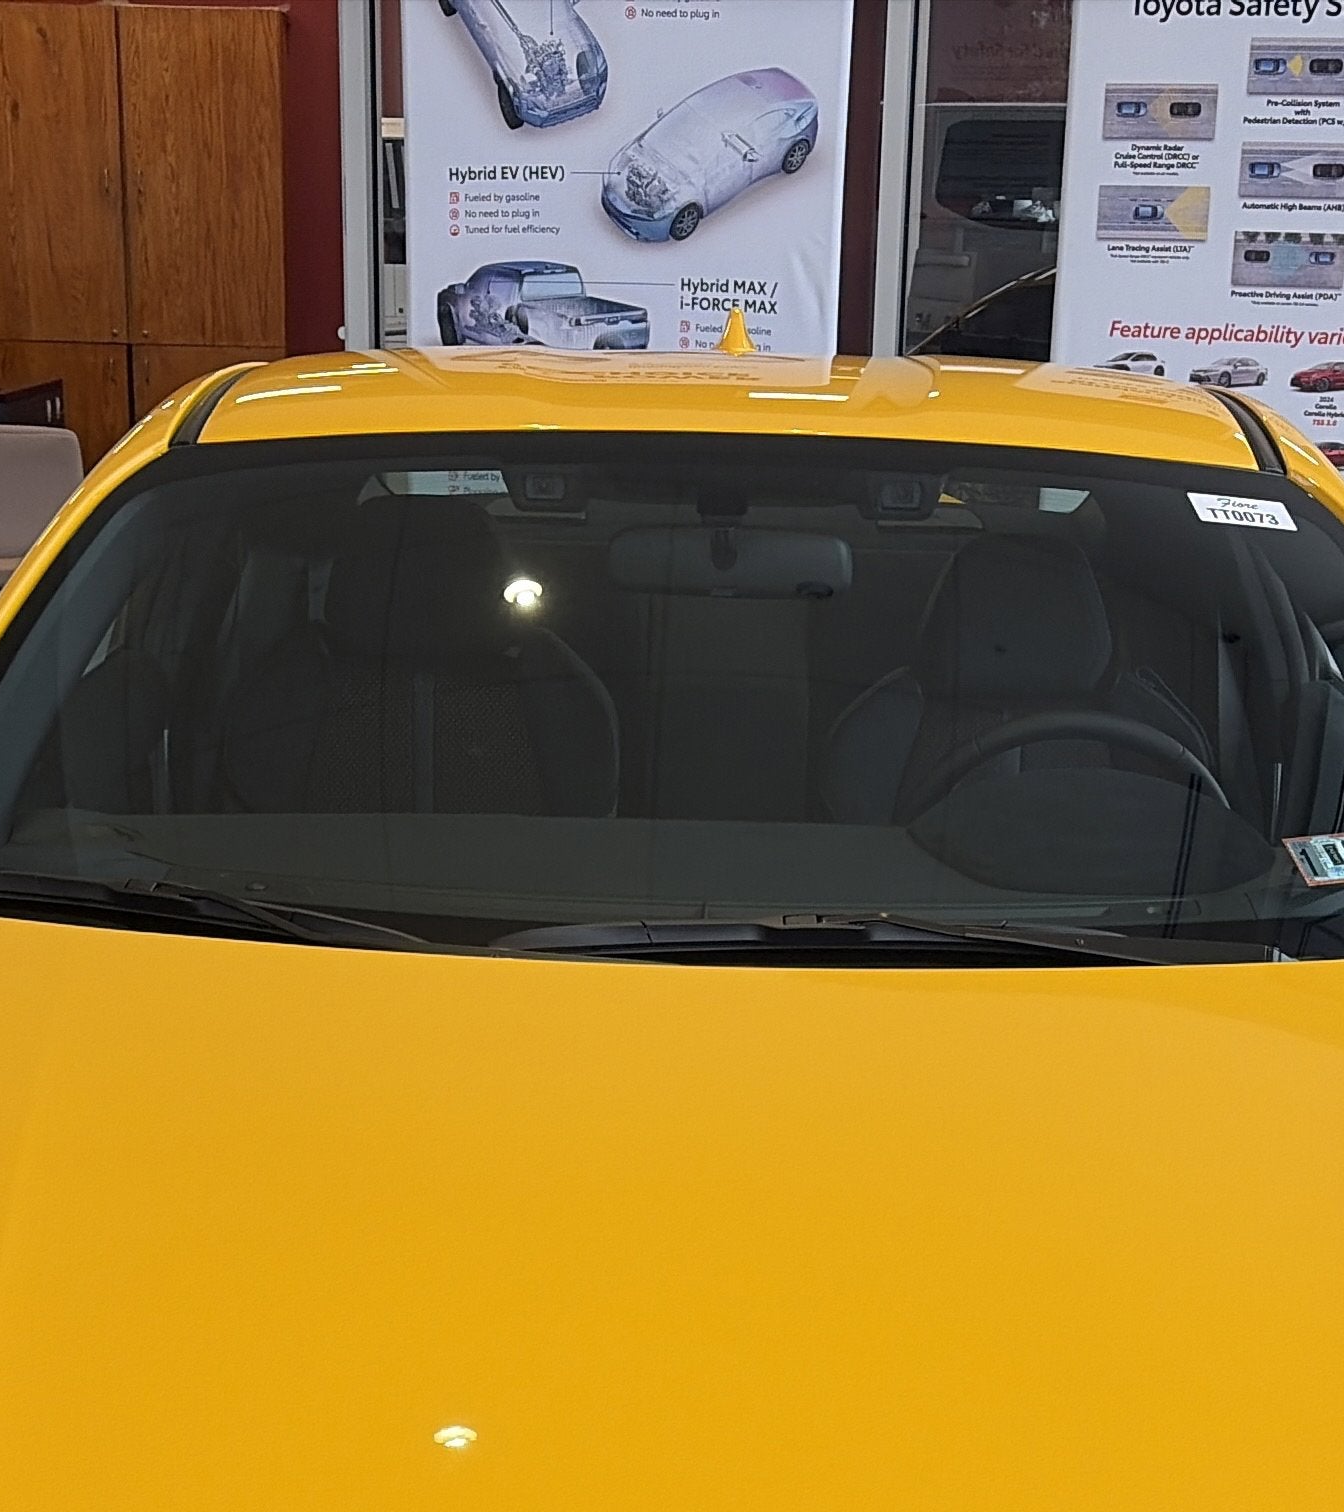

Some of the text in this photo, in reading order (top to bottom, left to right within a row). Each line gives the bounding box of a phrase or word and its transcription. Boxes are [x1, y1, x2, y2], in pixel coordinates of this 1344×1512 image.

[641, 8, 720, 20] No need to plug in
[1229, 0, 1319, 24] Safety
[449, 164, 565, 184] Hybrid EV (HEV)
[464, 192, 540, 203] Fueled by gasoline
[465, 208, 540, 219] No need to plug in
[465, 224, 560, 236] Tuned for fuel efficiency
[680, 277, 729, 295] Hybrid
[733, 279, 768, 296] MAX
[680, 296, 778, 315] i-FORCE MAX
[695, 323, 723, 333] Fueled
[1109, 320, 1181, 340] Feature
[1185, 323, 1304, 348] applicability
[695, 340, 707, 348] No
[1217, 498, 1258, 510] Fiore
[1206, 507, 1279, 526] TT0073
